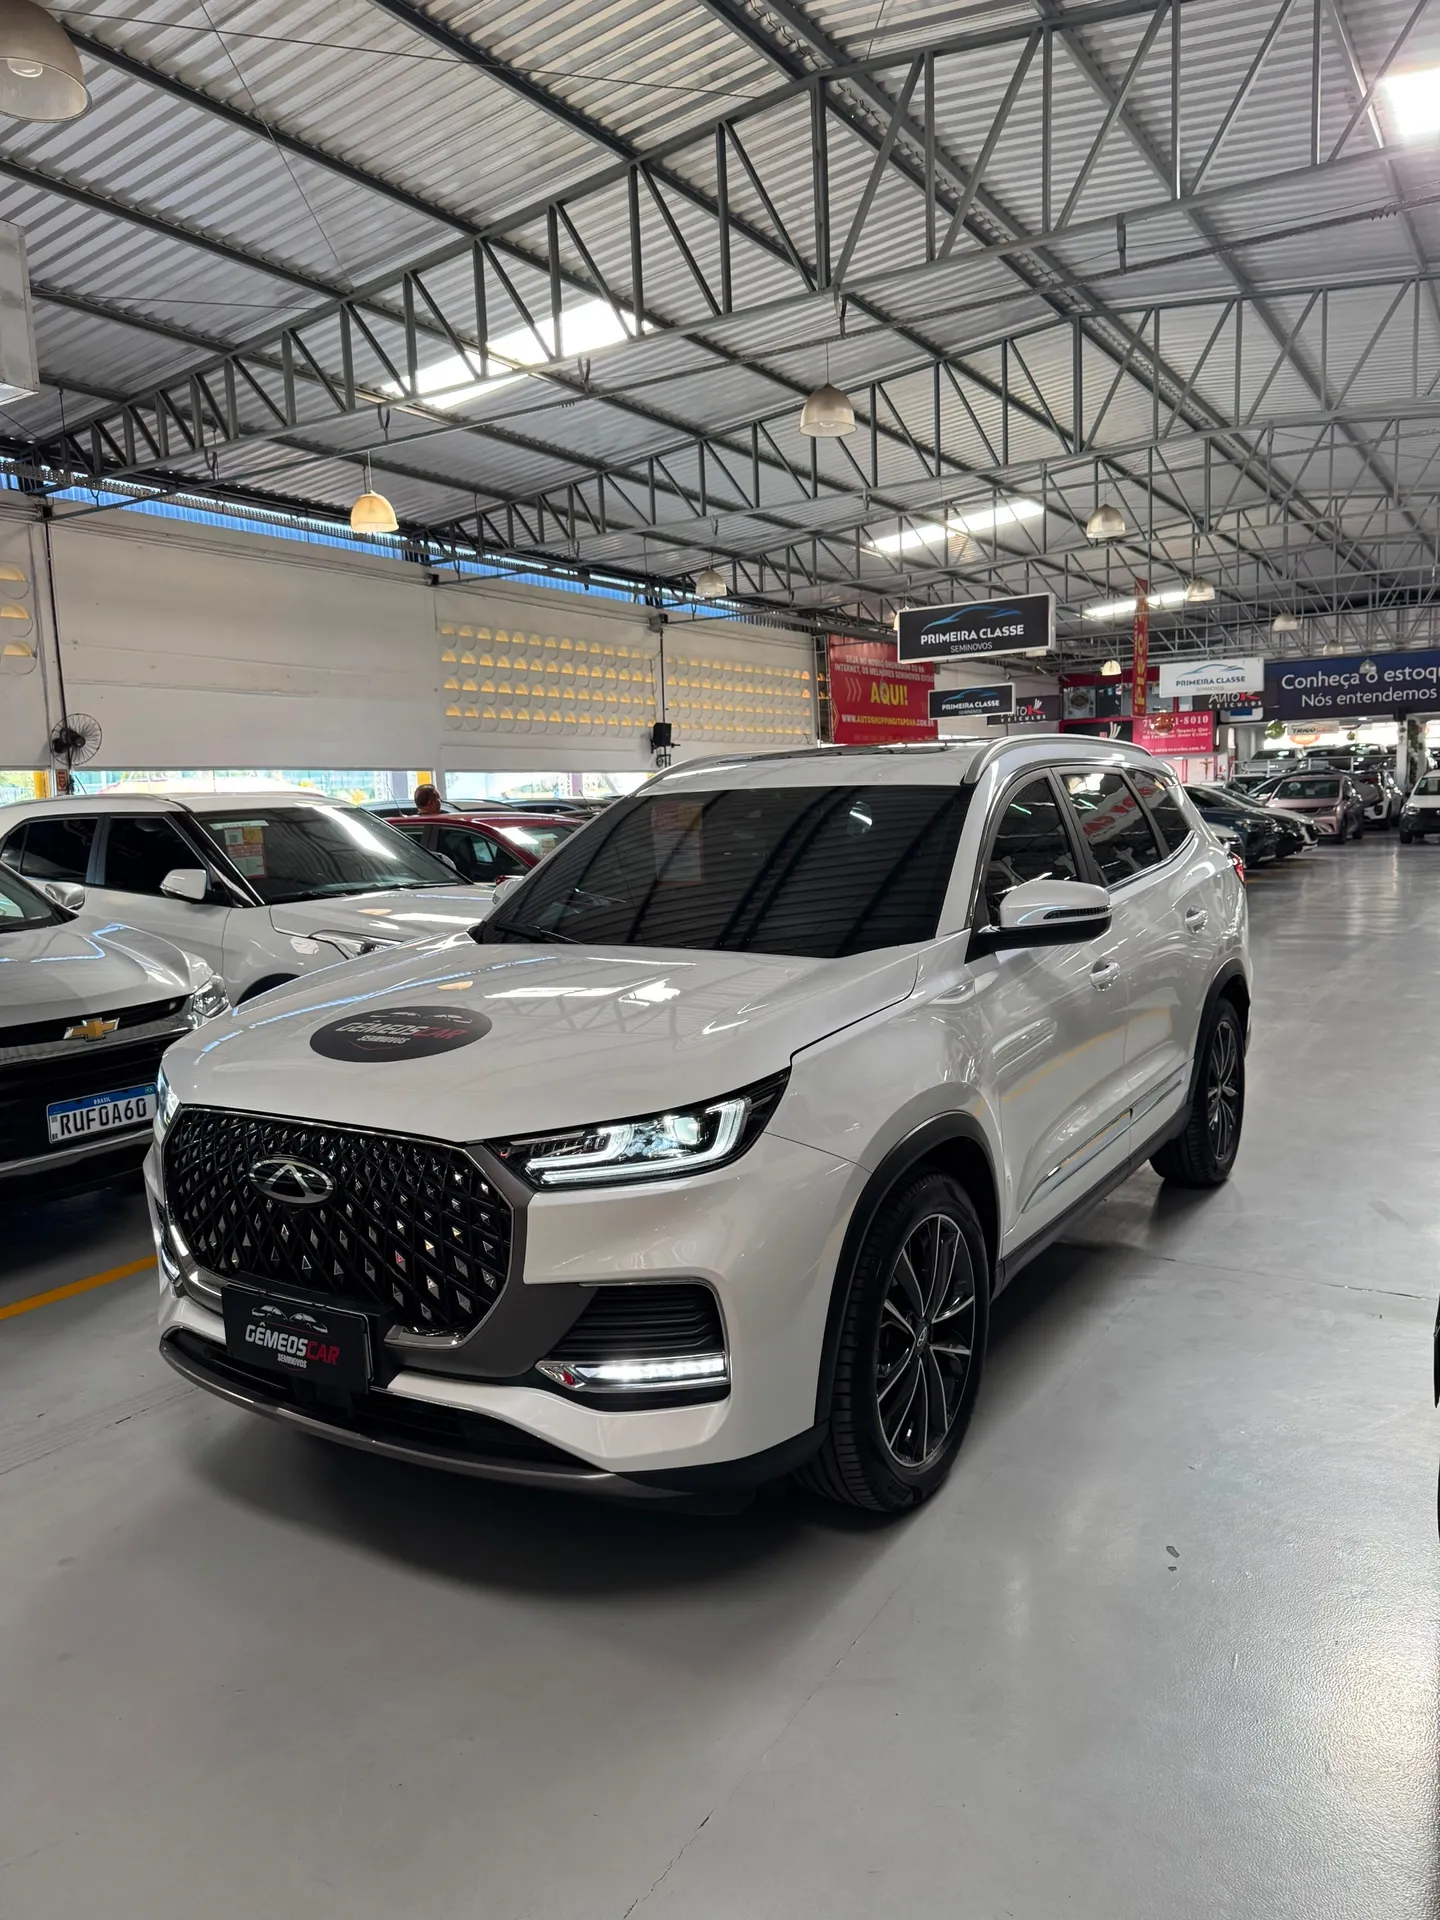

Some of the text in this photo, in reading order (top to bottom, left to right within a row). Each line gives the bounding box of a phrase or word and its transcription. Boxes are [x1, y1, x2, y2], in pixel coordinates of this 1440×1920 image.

[920, 624, 1024, 645] PRIMEIRA CLASSE
[950, 641, 993, 653] SEMINOVOS
[1175, 676, 1246, 687] PRIMEIRA CLASSE
[1281, 666, 1440, 690] Conheça o estoq
[870, 681, 909, 706] AQUI!
[1301, 687, 1437, 708] Nós entendemos
[942, 699, 1000, 711] PRIMEIRA CLASSE
[93, 1096, 112, 1105] BRASIL
[51, 1132, 59, 1140] BR
[245, 1321, 340, 1366] GÊMEOSCAR
[277, 1353, 308, 1369] SEMINOVOS
